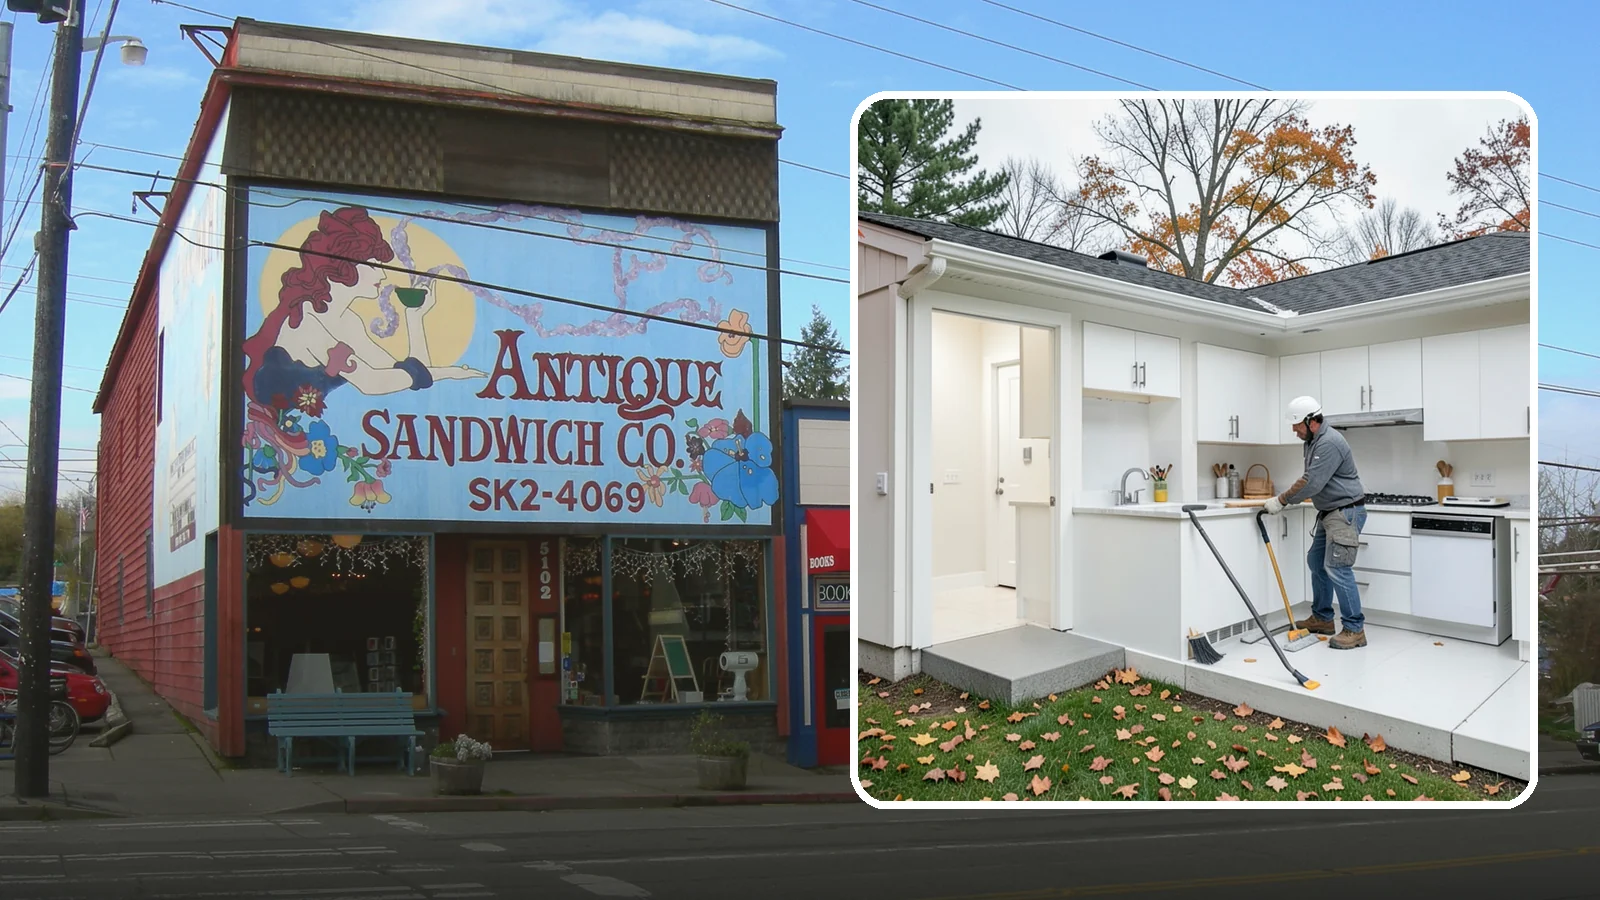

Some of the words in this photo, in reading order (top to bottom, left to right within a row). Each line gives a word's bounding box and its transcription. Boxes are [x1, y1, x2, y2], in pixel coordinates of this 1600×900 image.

[475, 329, 724, 421] ANTIQUE
[361, 408, 604, 468] SANDWICH
[617, 421, 685, 469] CO.
[468, 477, 646, 513] SK2-4069
[539, 541, 552, 600] 5102
[809, 555, 835, 569] BOOKS
